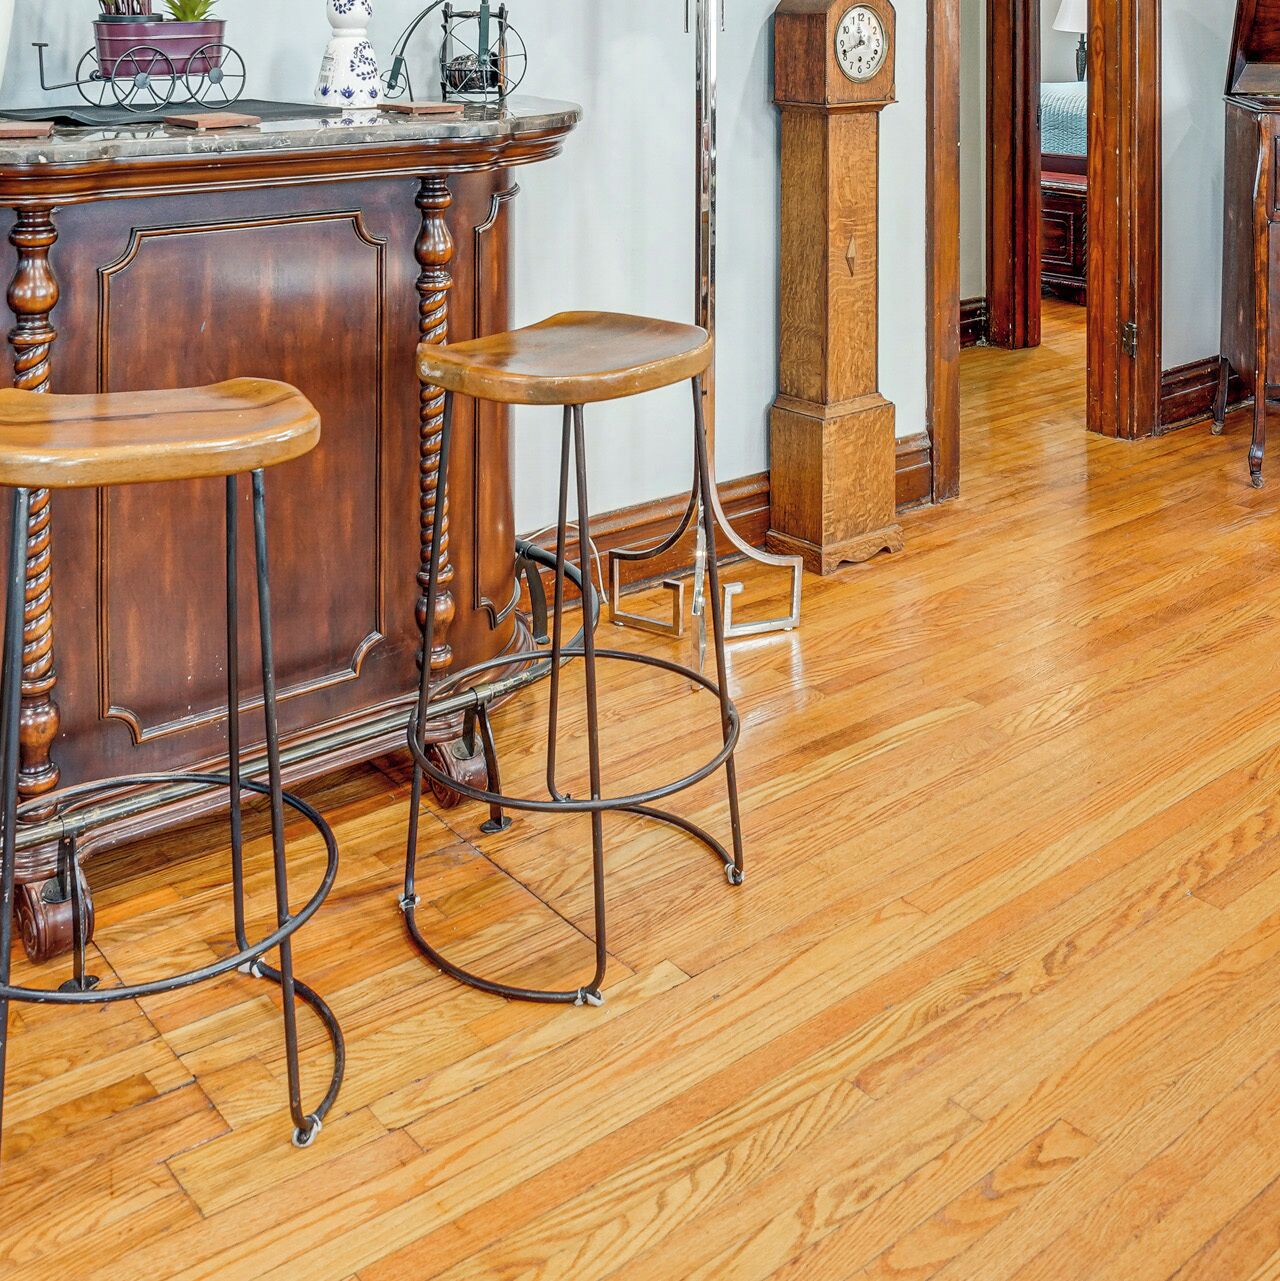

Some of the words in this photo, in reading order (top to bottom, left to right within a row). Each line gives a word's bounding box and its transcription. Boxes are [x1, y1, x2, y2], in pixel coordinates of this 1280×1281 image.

[857, 13, 865, 22] 12
[842, 25, 850, 35] 10
[872, 26, 877, 35] 2
[839, 39, 845, 49] 9
[875, 38, 881, 48] 3
[849, 61, 855, 70] 7
[857, 64, 863, 74] 6
[865, 60, 871, 70] 5
